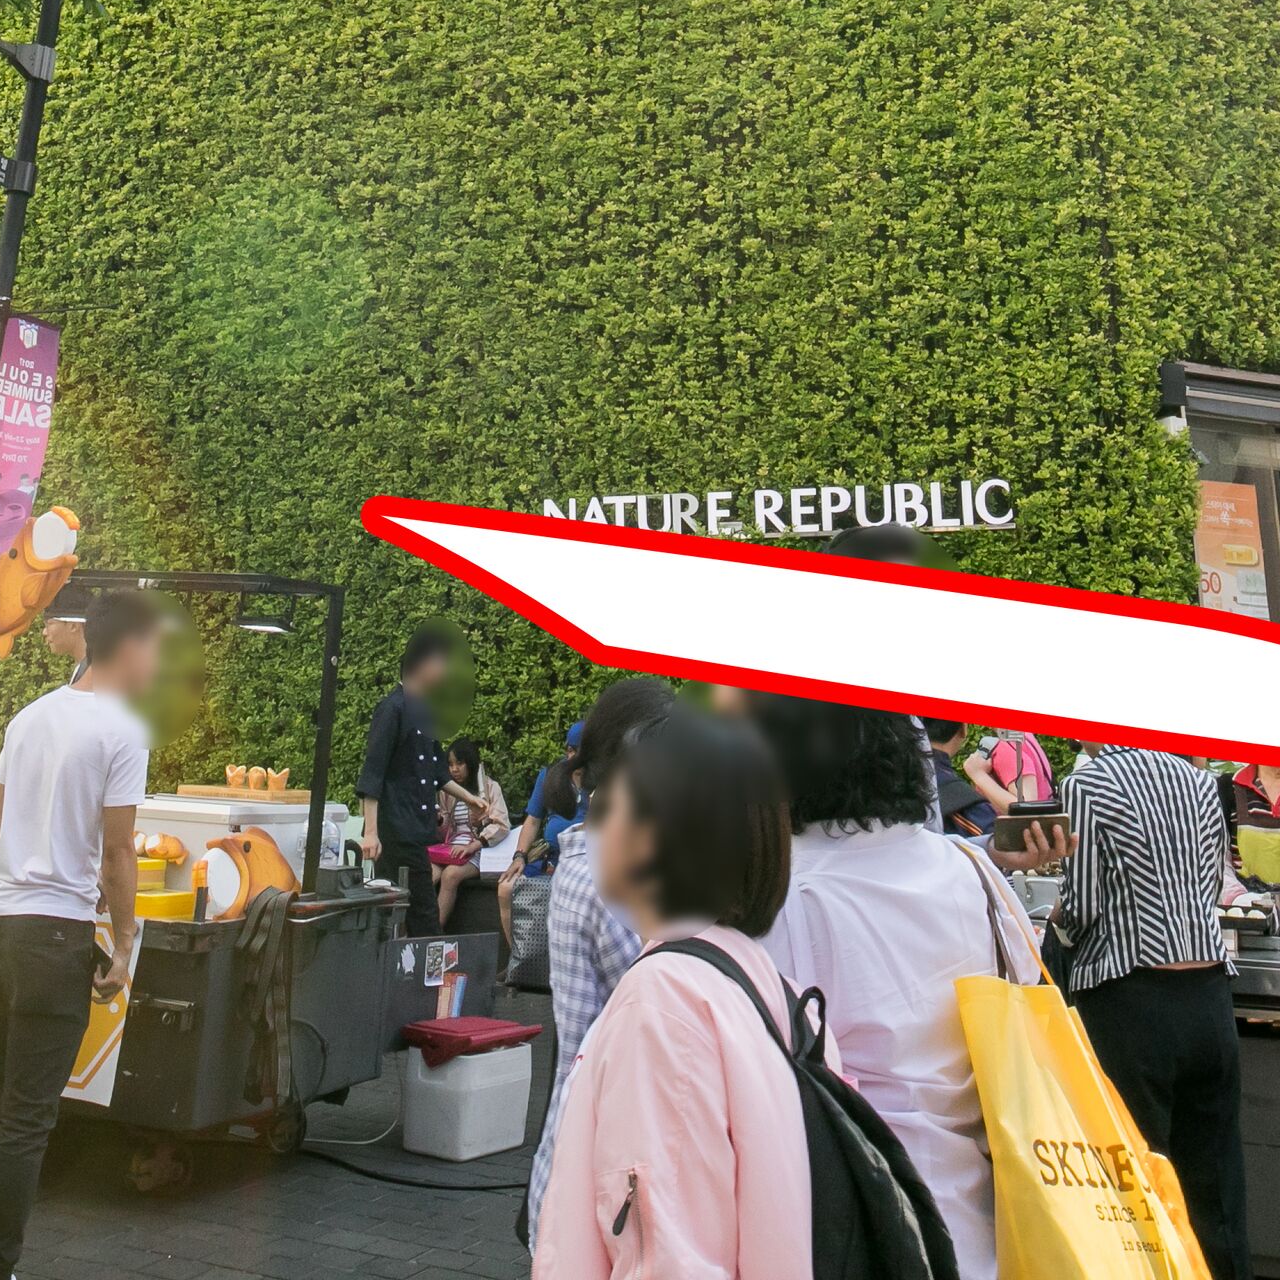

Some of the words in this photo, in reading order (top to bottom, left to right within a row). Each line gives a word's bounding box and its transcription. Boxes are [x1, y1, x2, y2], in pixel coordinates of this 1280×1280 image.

[754, 478, 1015, 534] REPUBLIC
[1095, 1201, 1138, 1224] since
[1136, 1240, 1165, 1254] seou
